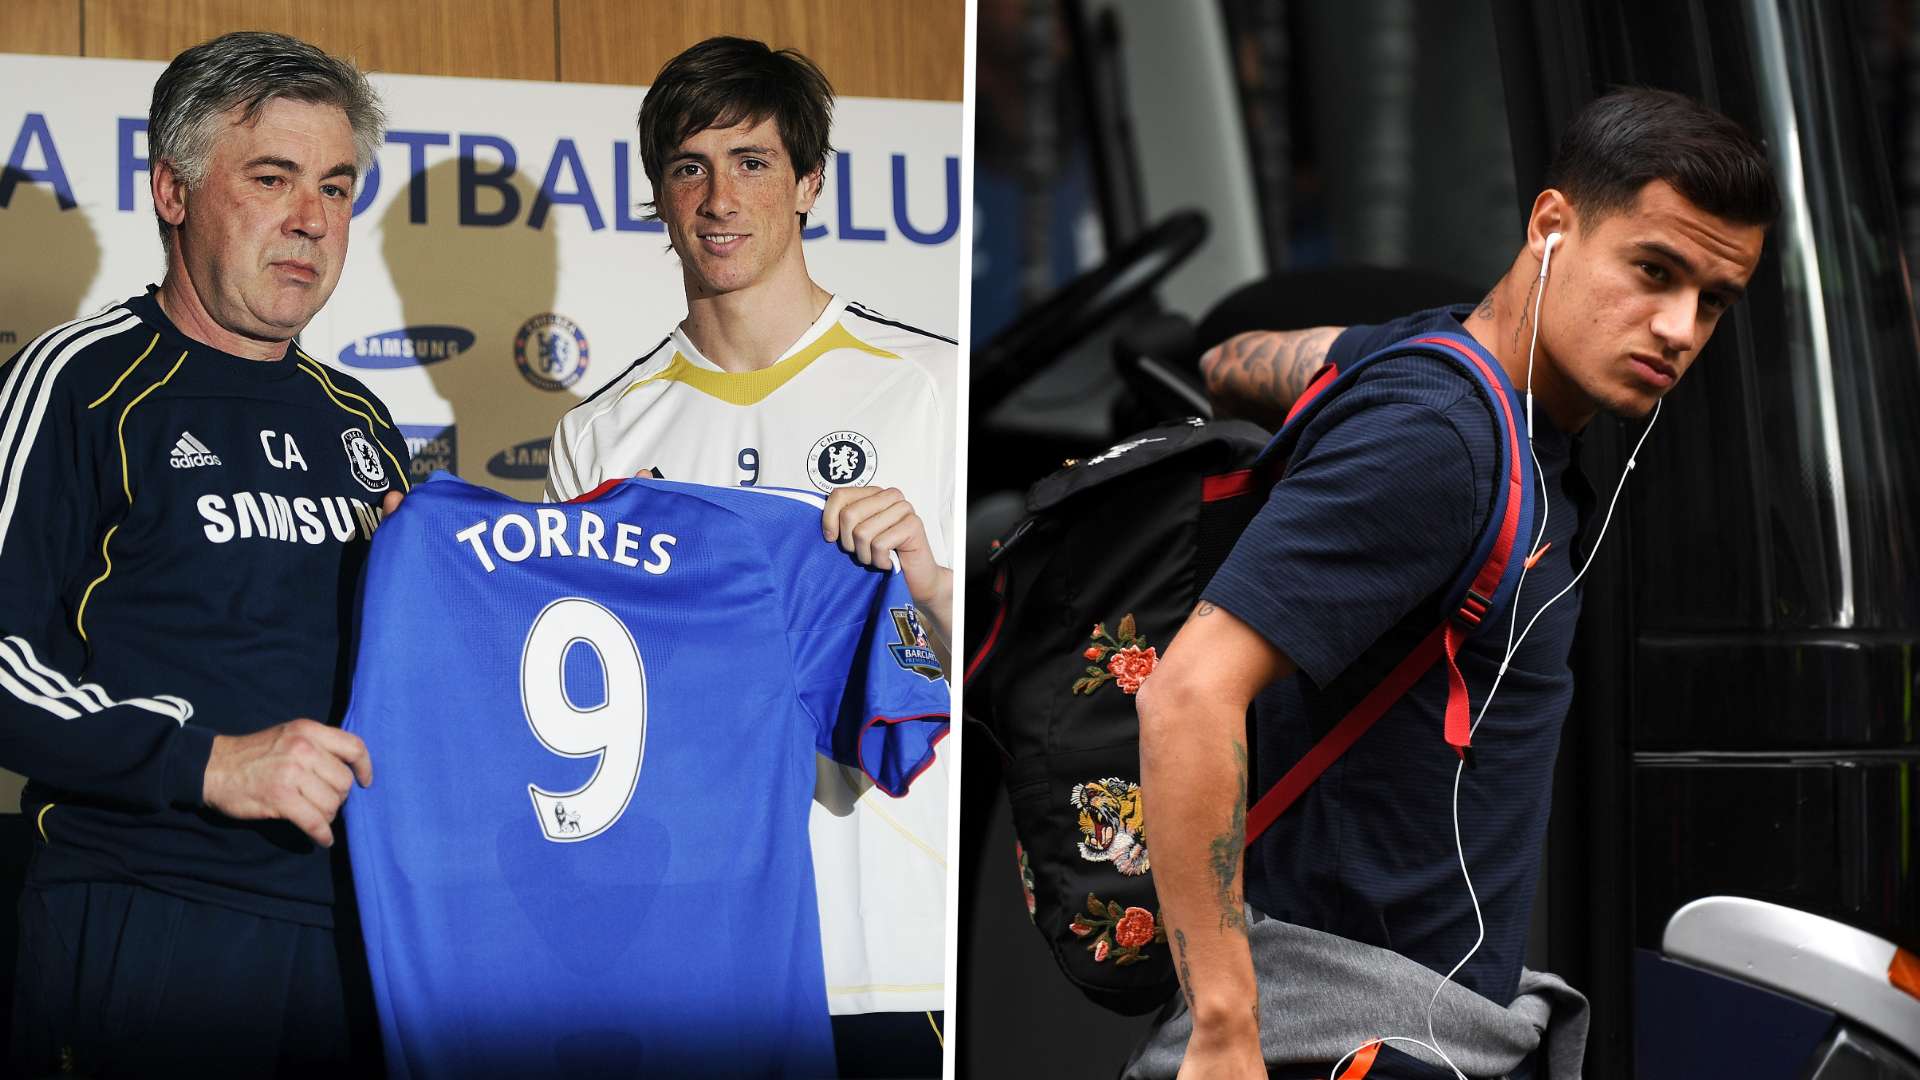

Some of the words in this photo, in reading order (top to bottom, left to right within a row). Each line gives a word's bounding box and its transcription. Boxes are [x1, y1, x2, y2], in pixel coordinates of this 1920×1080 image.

[801, 152, 961, 245] LU
[353, 336, 460, 359] SAMSUNG
[260, 430, 308, 471] CA
[820, 433, 864, 448] CHELSEA
[169, 454, 222, 469] adidas
[737, 447, 760, 487] 9
[456, 508, 677, 576] TORRES
[520, 596, 648, 843] 9
